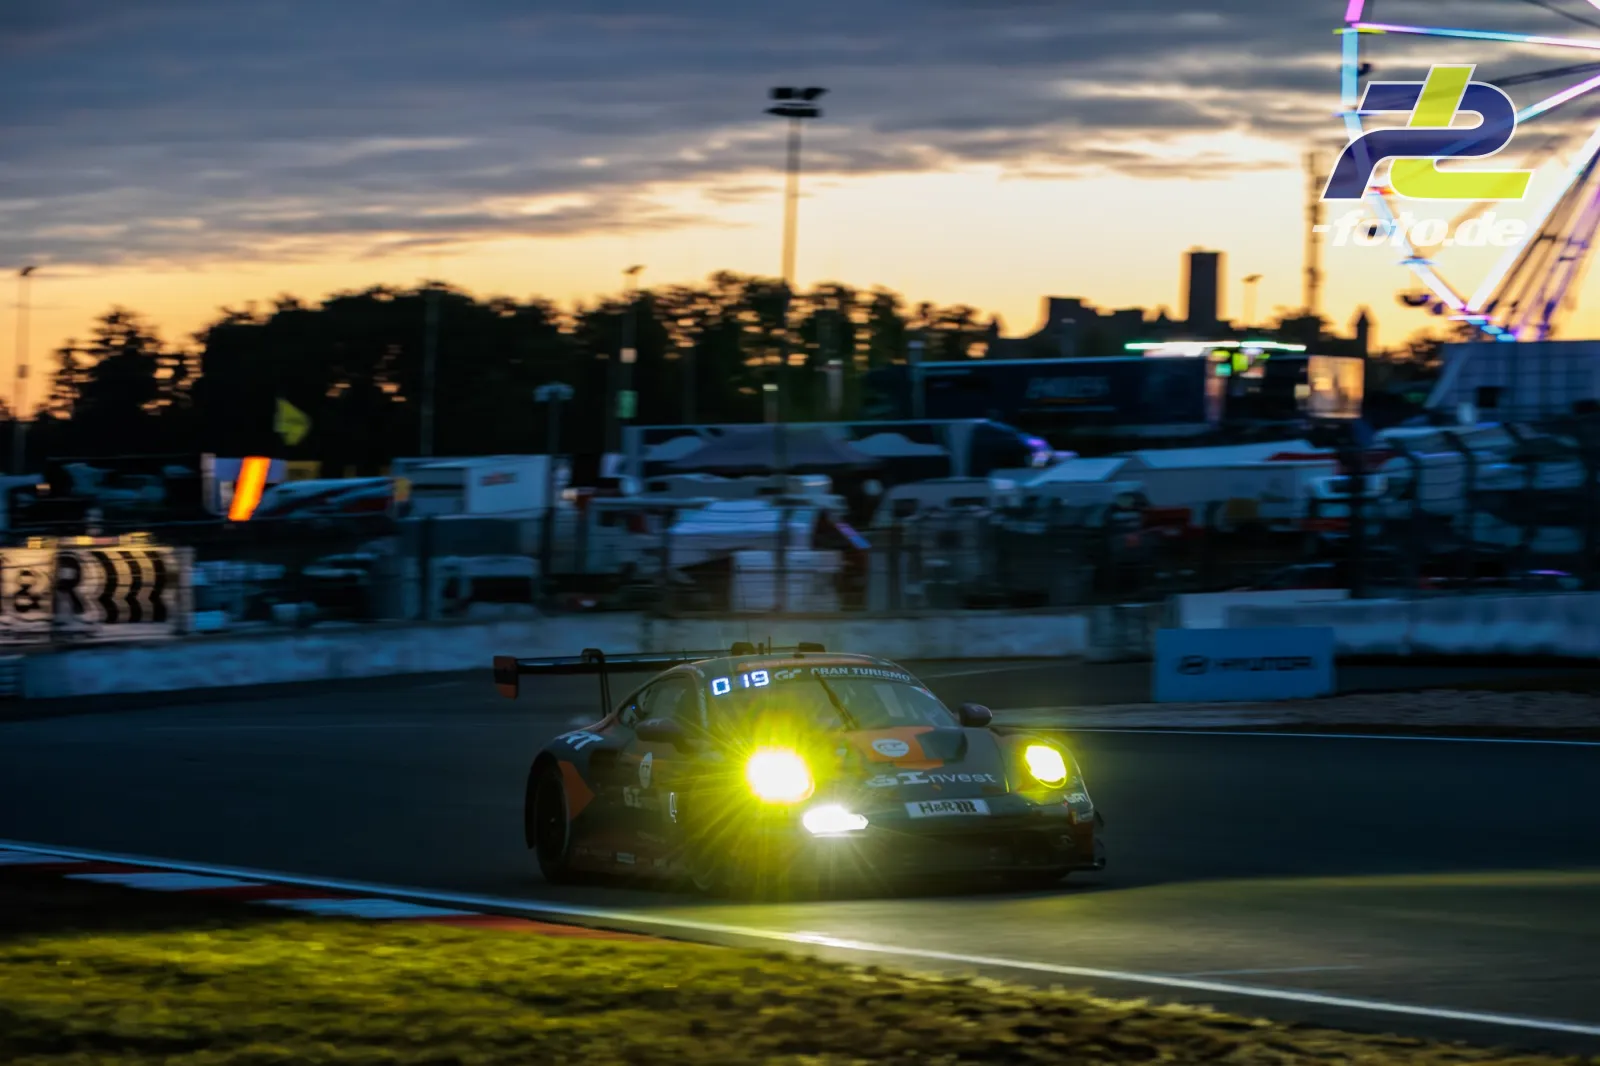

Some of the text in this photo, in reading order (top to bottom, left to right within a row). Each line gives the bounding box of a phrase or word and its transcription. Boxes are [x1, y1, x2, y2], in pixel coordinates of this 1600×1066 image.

[811, 667, 911, 681] GRAN TURISMO
[918, 800, 955, 815] H&R
